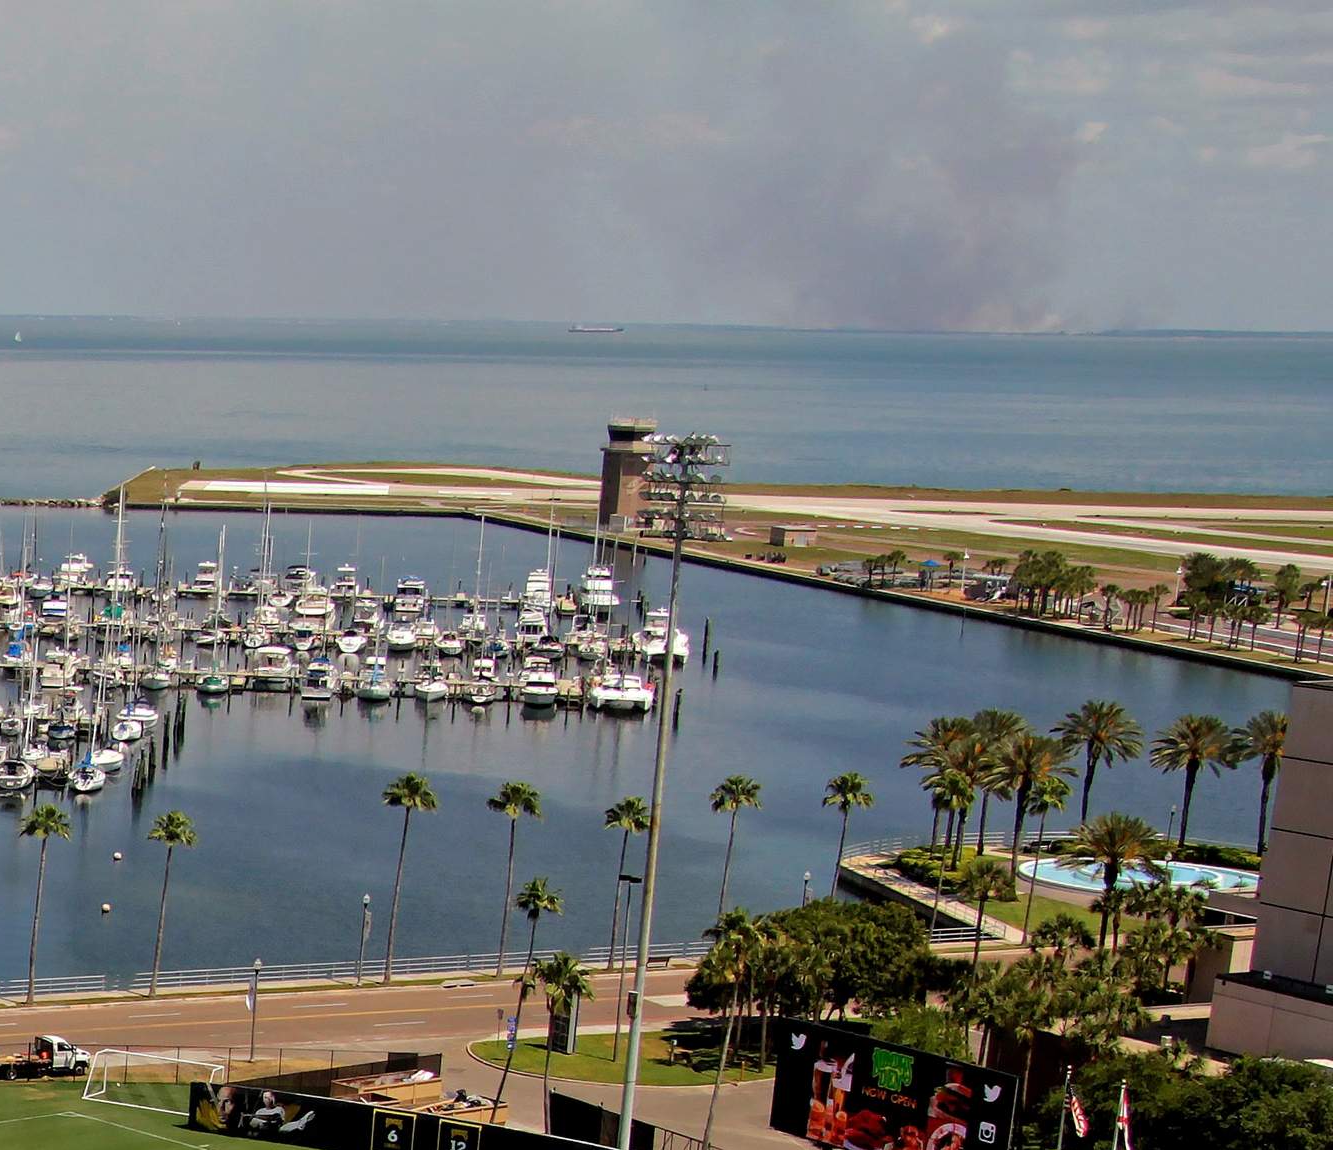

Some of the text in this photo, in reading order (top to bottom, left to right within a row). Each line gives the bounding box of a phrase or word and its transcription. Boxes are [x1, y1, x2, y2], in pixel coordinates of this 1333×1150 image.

[862, 1087, 917, 1109] NOW OPEN
[387, 1130, 398, 1142] 6
